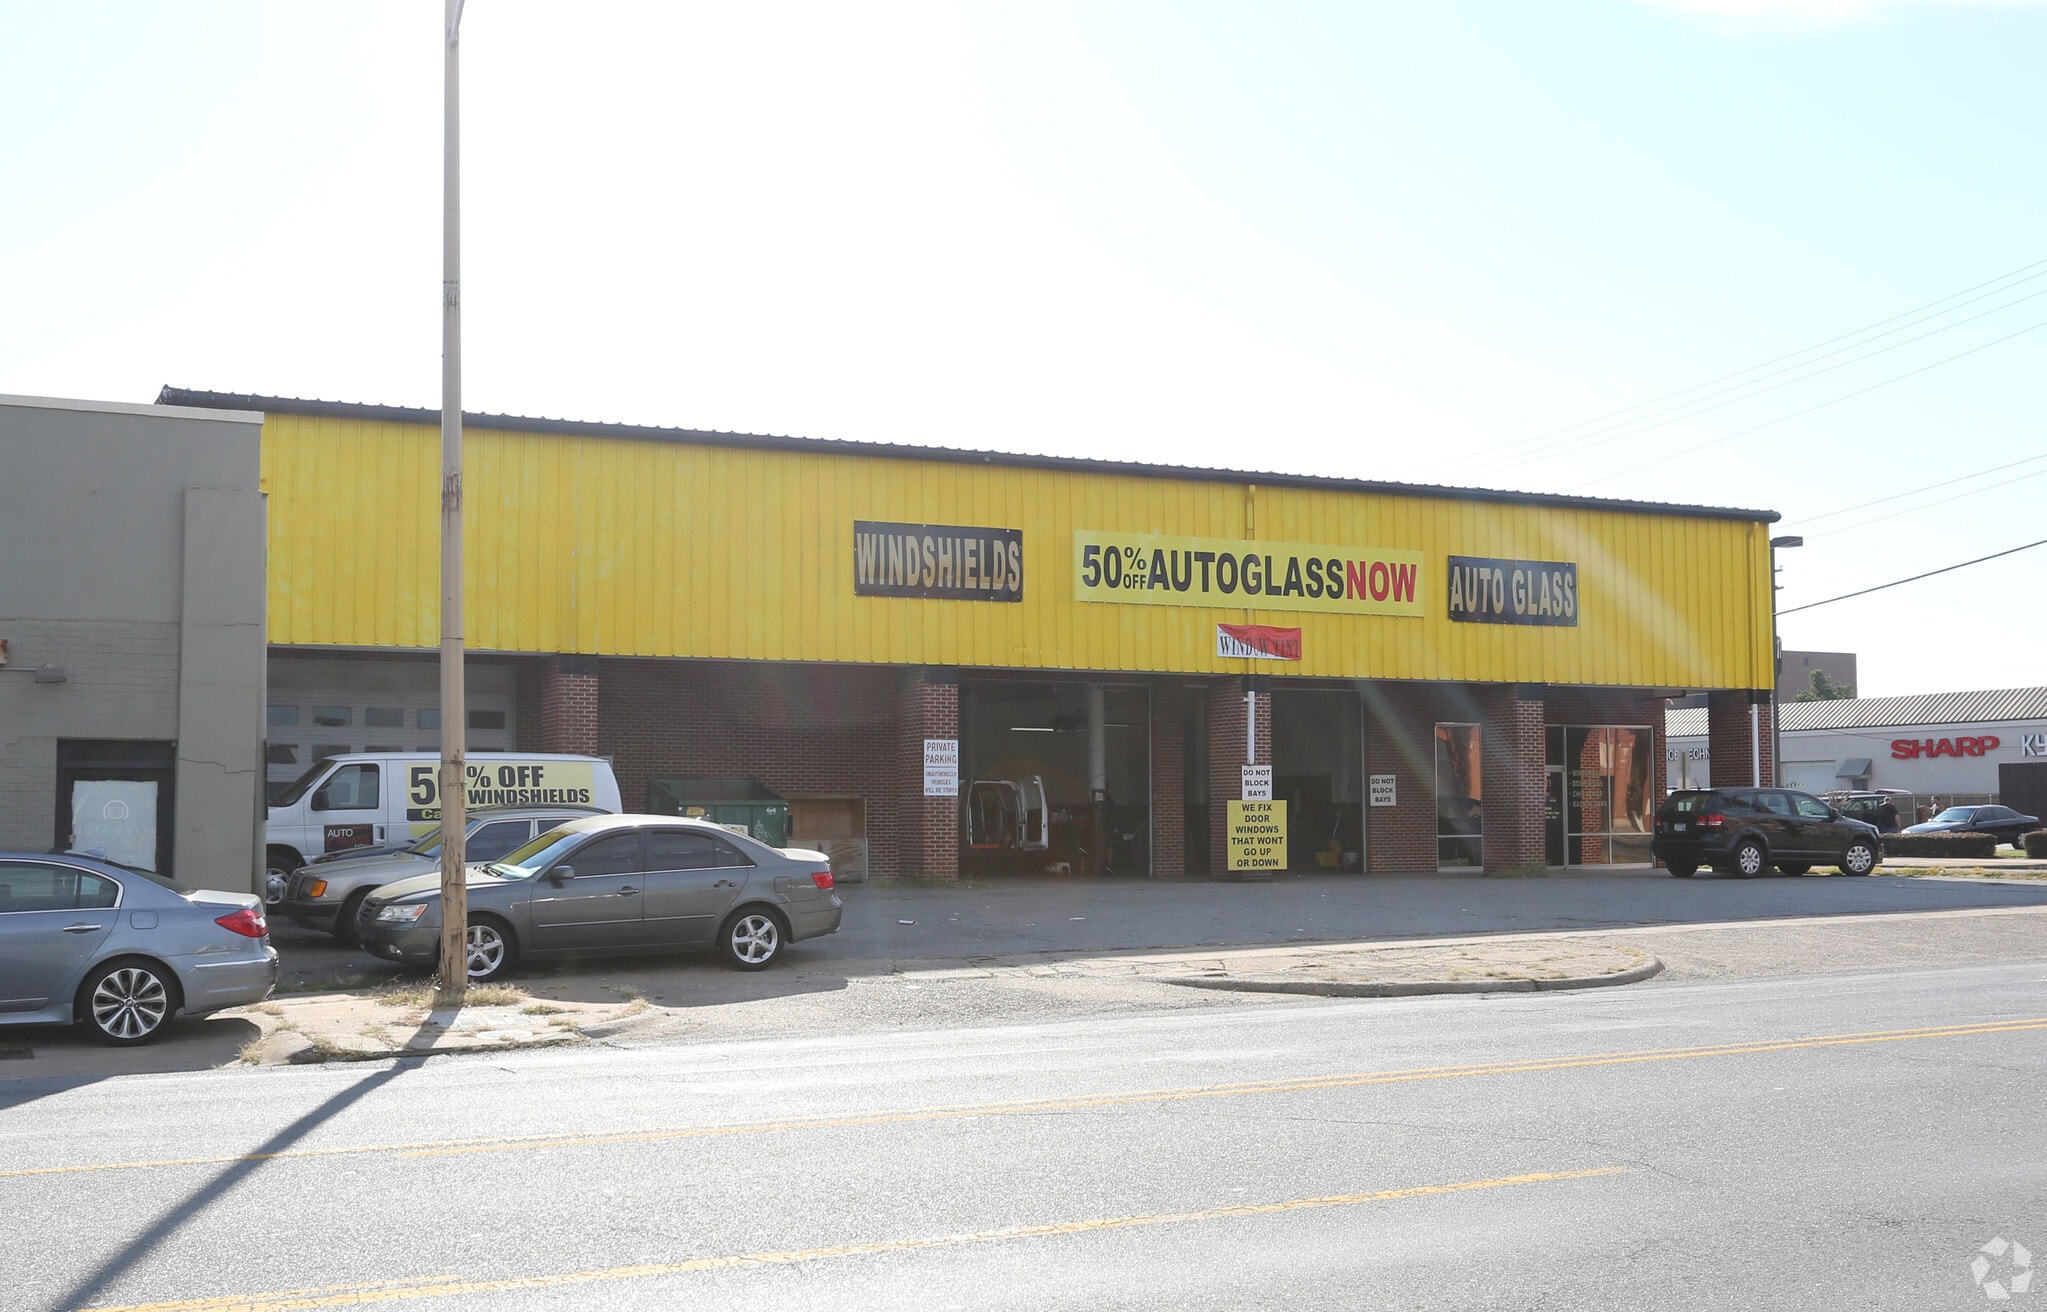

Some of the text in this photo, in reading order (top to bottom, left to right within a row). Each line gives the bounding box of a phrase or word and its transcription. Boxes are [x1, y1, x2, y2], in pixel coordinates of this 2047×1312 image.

[856, 532, 1020, 592] WINDSHIELDS
[1123, 573, 1147, 589] OFF
[1450, 566, 1574, 618] AUTO GLASS
[1220, 636, 1300, 658] WINDOW TINT
[926, 742, 956, 752] PRIVATE
[1891, 735, 2000, 760] SHARP
[925, 754, 957, 764] PARKING
[498, 765, 544, 788] OFF
[468, 788, 590, 805] WINDSHIELDS
[1244, 815, 1270, 823] DOOR
[327, 828, 354, 837] AUTO
[1235, 826, 1280, 834] WINDOWS
[1231, 837, 1284, 845] THAT WONT
[1243, 848, 1272, 856] GO UP
[1236, 859, 1279, 867] OR DOWN
